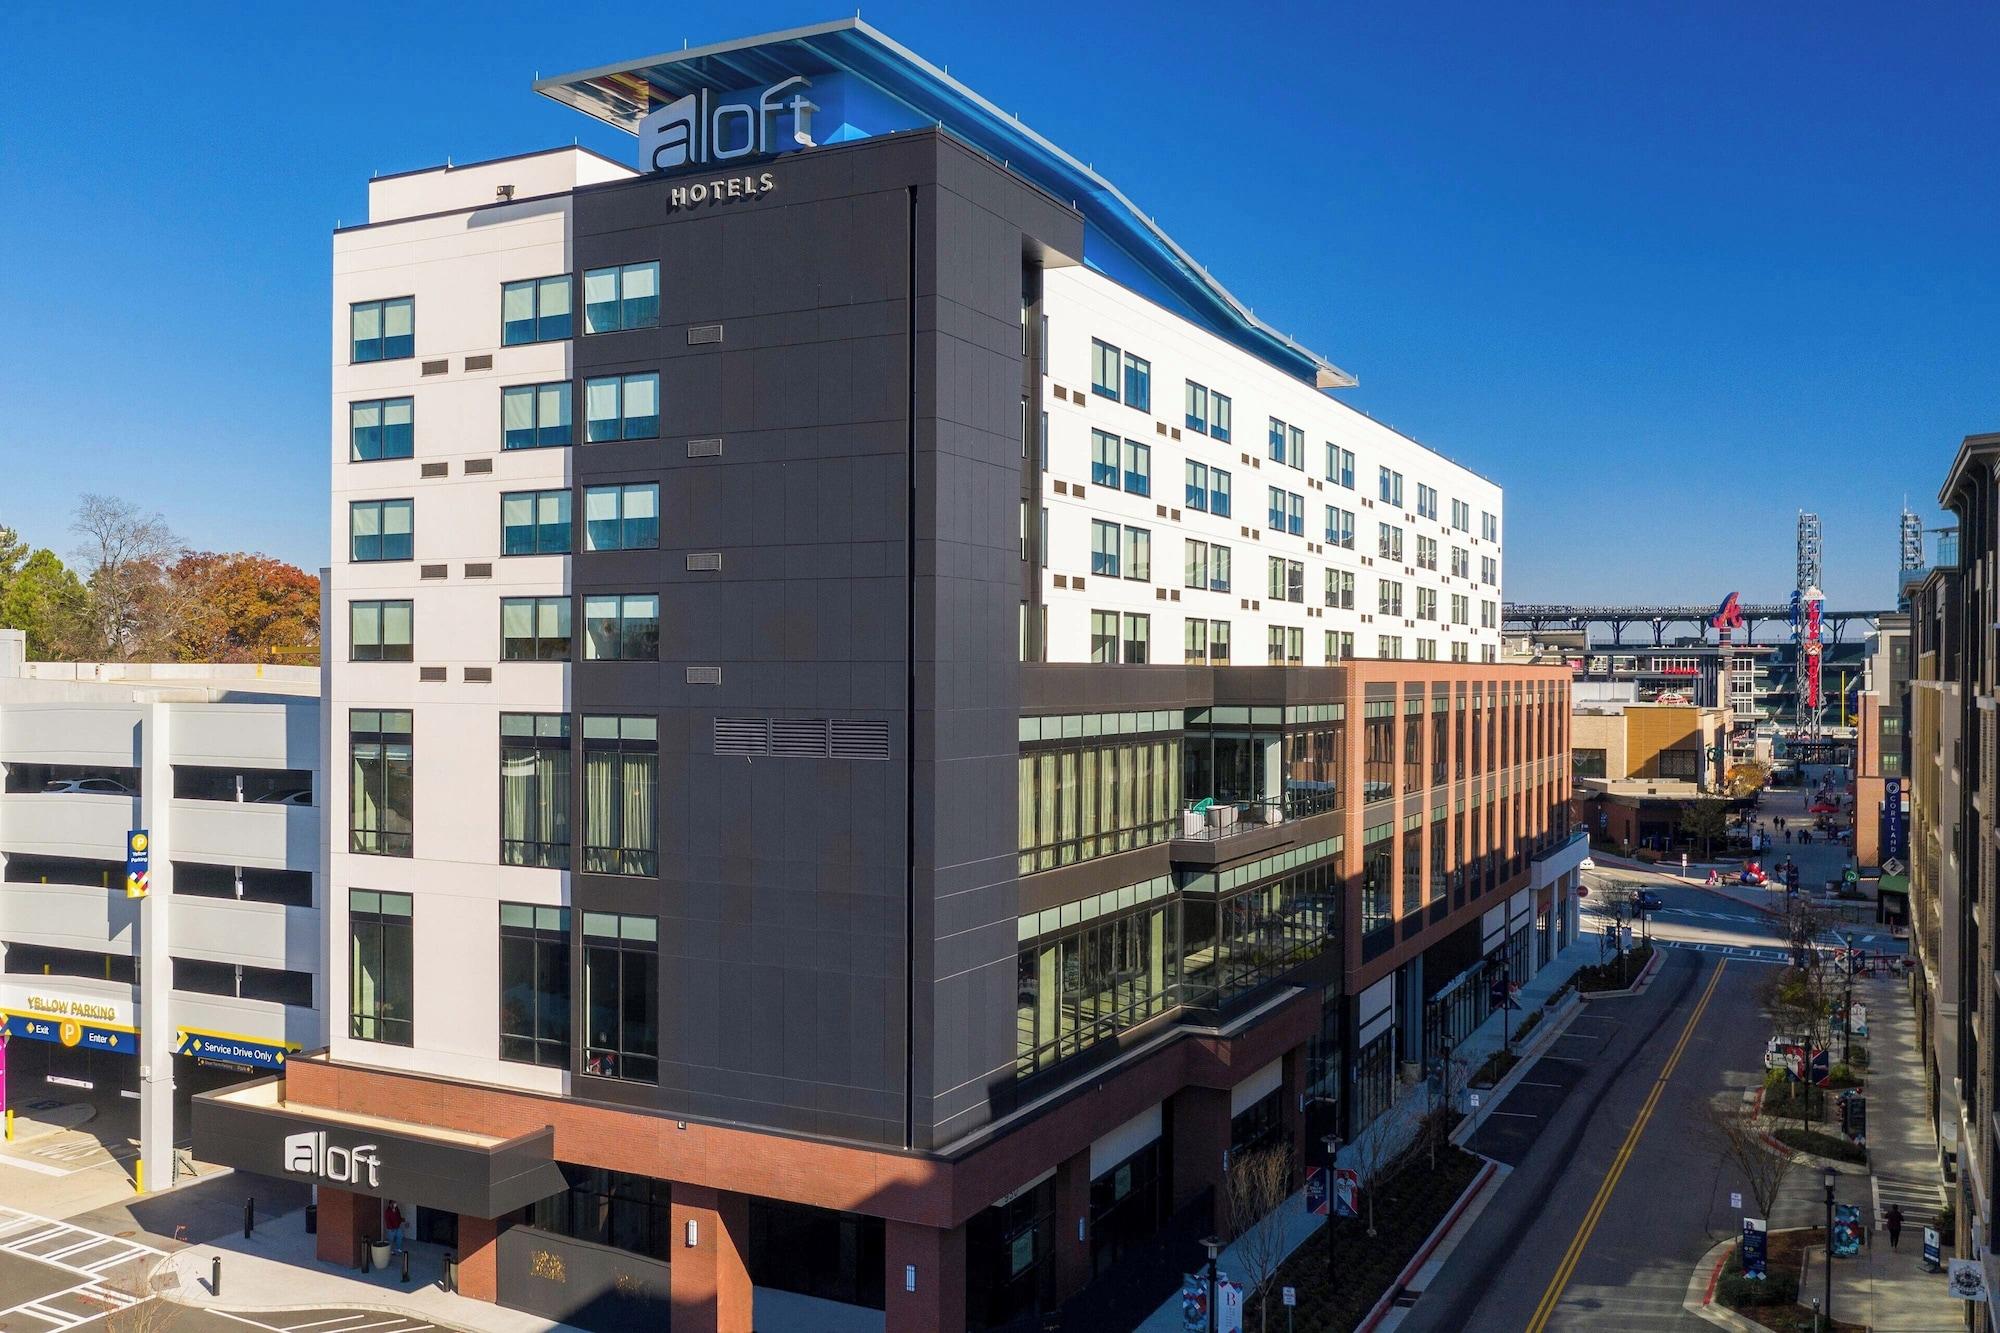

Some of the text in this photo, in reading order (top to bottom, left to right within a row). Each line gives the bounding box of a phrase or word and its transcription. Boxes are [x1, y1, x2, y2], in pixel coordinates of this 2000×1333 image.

[639, 75, 819, 173] aloft
[671, 173, 775, 206] HOTELS
[1889, 795, 1897, 853] CORTLAND
[27, 996, 116, 1021] YELLOW PARKING
[35, 1024, 49, 1035] Exit
[88, 1032, 108, 1044] Enter
[204, 1041, 273, 1063] Service Drive Only
[284, 1131, 381, 1187] aloft
